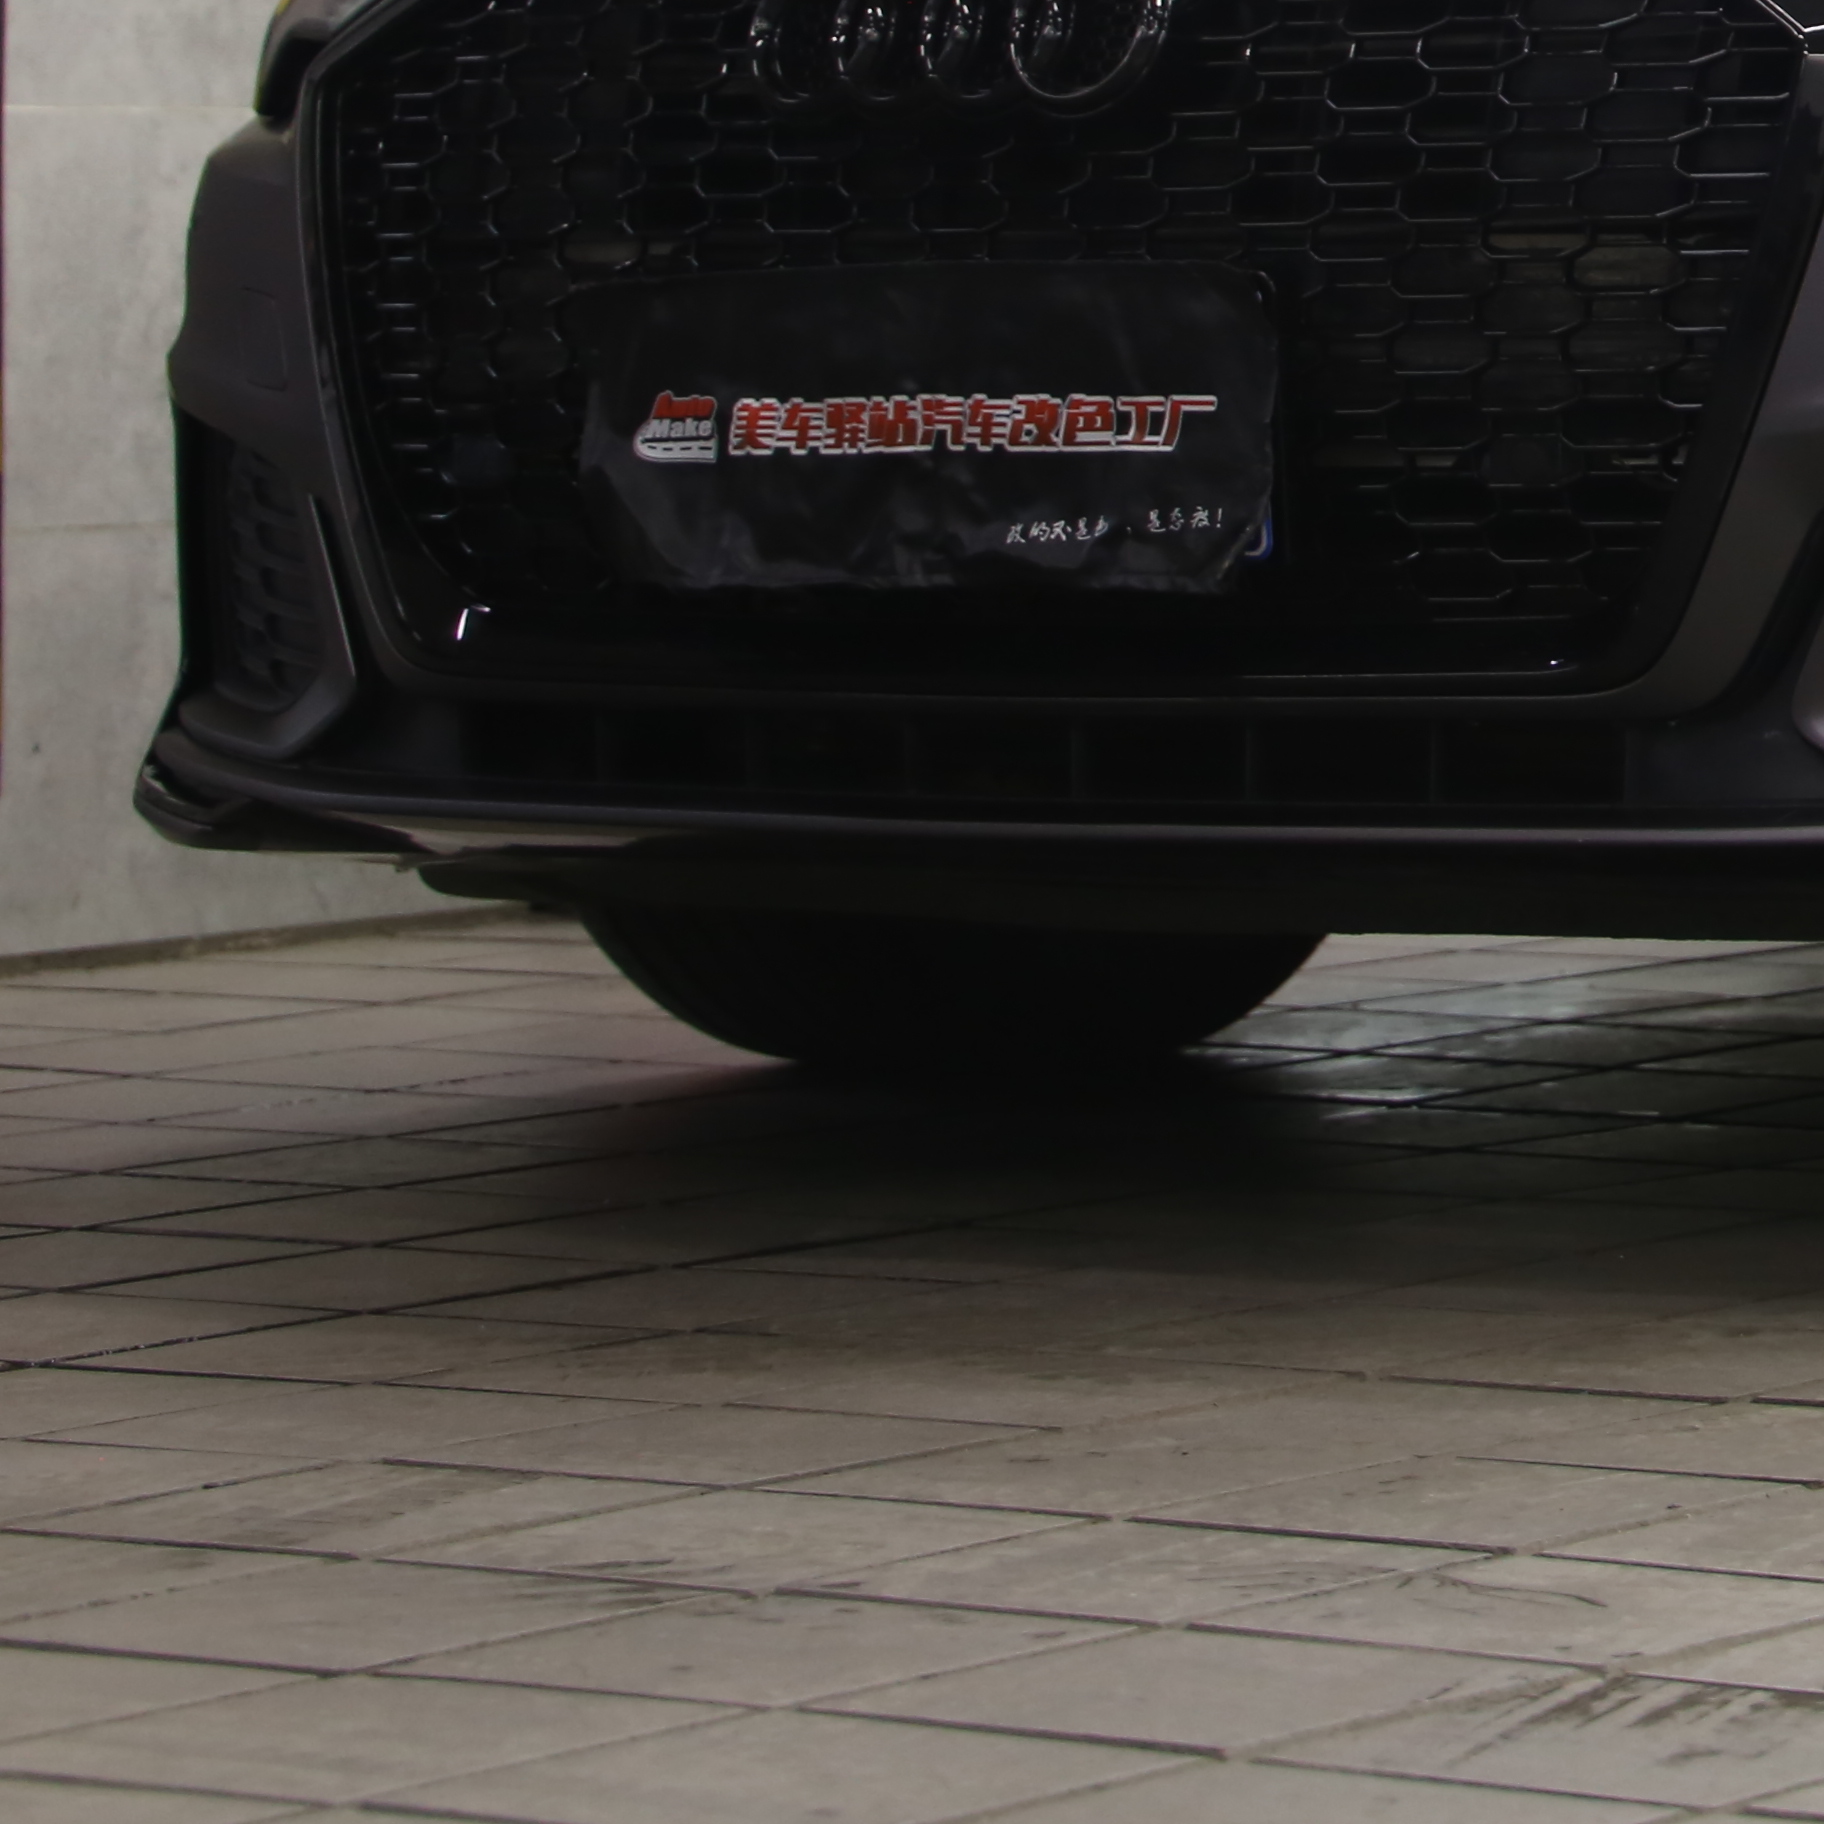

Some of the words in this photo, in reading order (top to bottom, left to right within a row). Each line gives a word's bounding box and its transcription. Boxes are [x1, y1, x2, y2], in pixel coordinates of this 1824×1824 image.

[645, 417, 712, 439] Make
[728, 393, 1217, 455] 美车驿站汽车改色工厂
